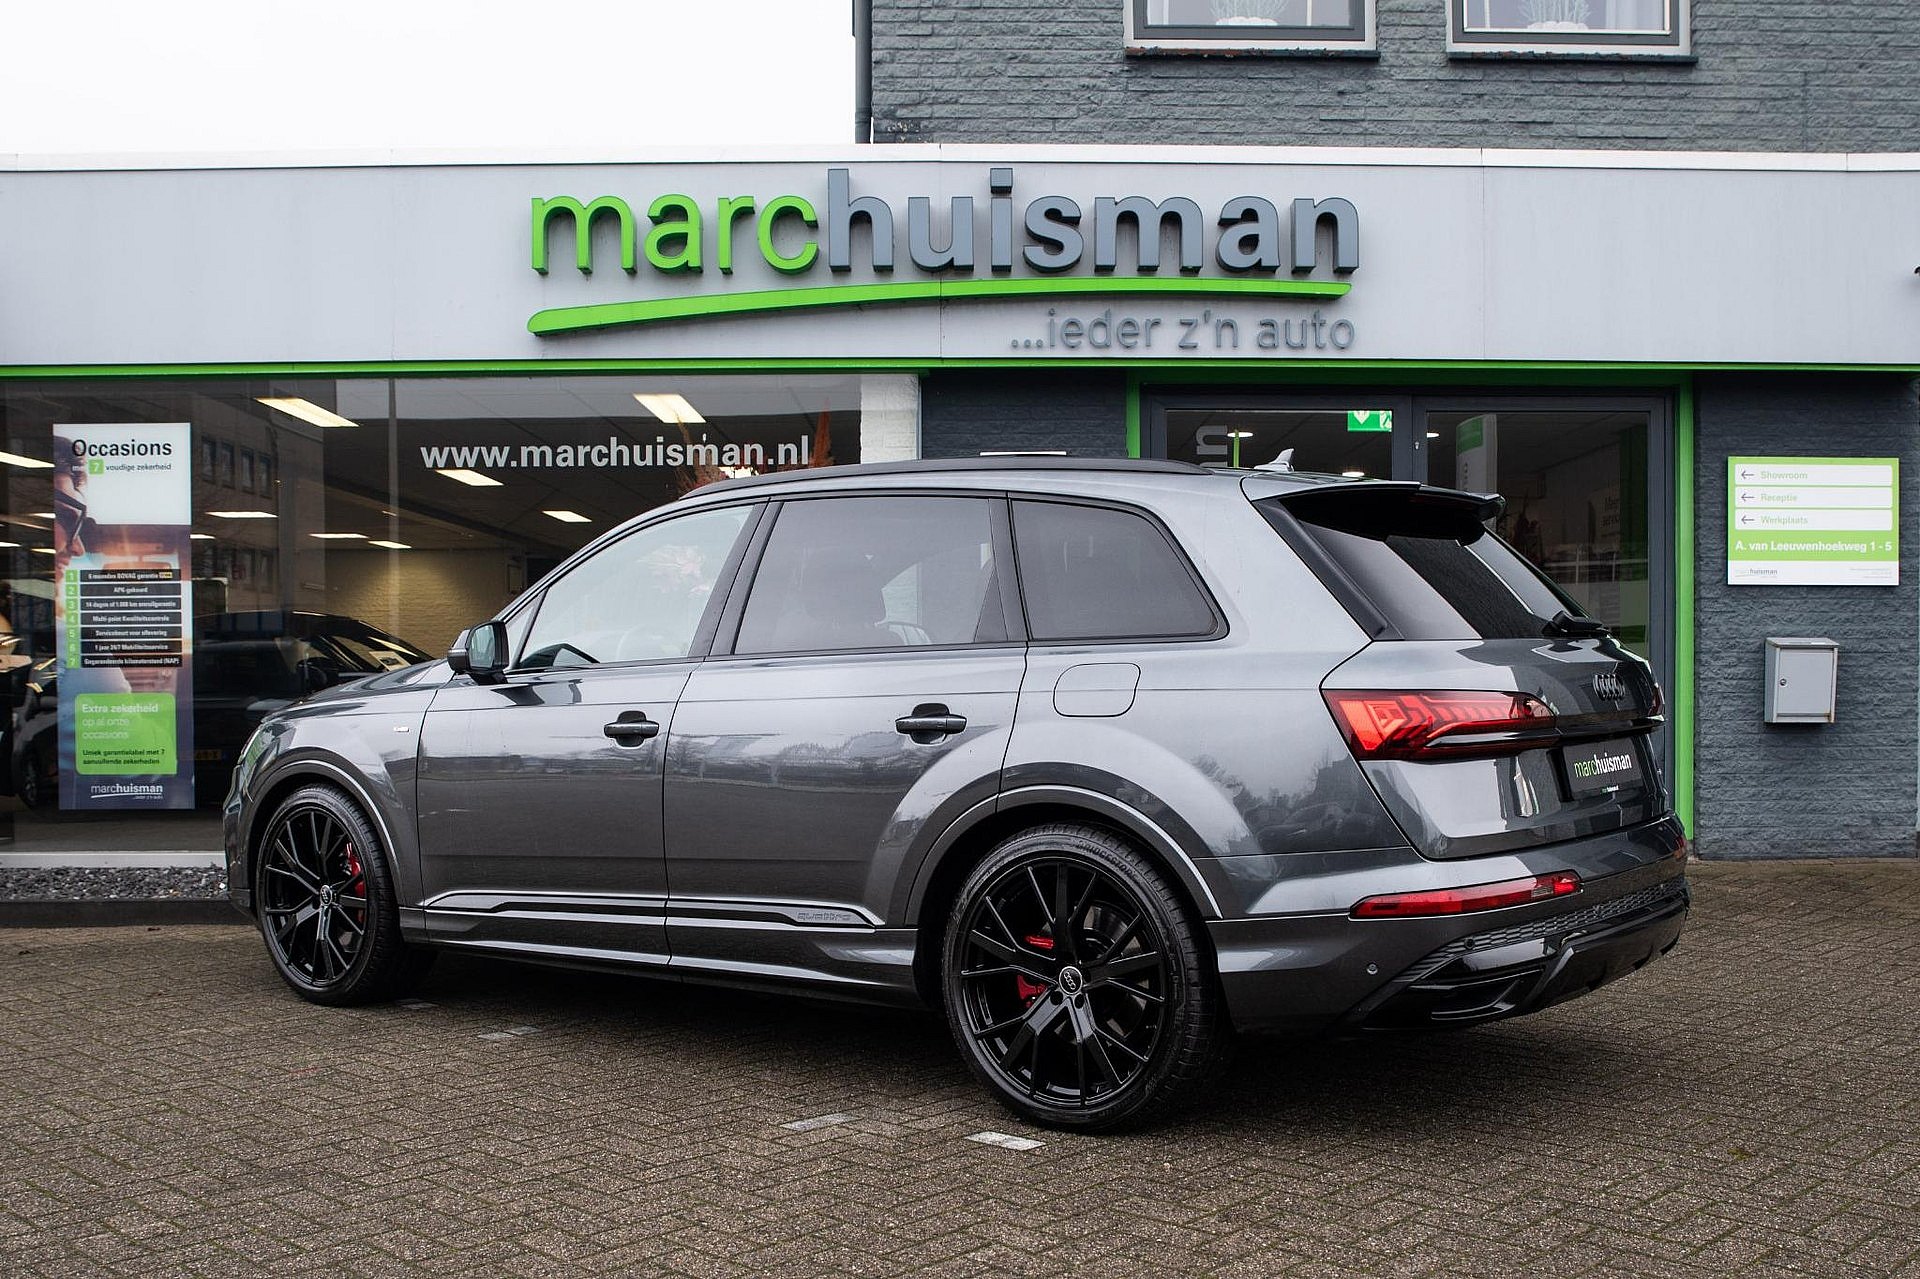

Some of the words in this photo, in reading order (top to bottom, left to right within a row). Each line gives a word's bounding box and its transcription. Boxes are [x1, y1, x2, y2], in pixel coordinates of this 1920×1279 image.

[531, 167, 1360, 275] marchuisman
[1011, 308, 1161, 349] ...ieder
[1178, 309, 1239, 349] z'n
[1257, 309, 1355, 349] auto
[72, 439, 172, 457] Occasions
[420, 435, 809, 468] www.marchuisman.nl
[106, 463, 136, 473] voudige
[137, 463, 172, 471] zekerheid
[1760, 470, 1809, 480] Showroom
[1760, 493, 1798, 504] Receptie
[1760, 516, 1809, 526] Werkplaats
[1735, 540, 1747, 551] A.
[1749, 542, 1768, 551] van
[1771, 540, 1867, 553] Leeuwenhoekweg
[1869, 541, 1876, 551] 1
[1885, 541, 1893, 551] 5
[82, 704, 108, 713] Extra
[111, 703, 159, 713] zekerheid
[146, 748, 160, 756] met
[1574, 751, 1633, 778] marchuisman
[90, 783, 163, 793] marchuisman
